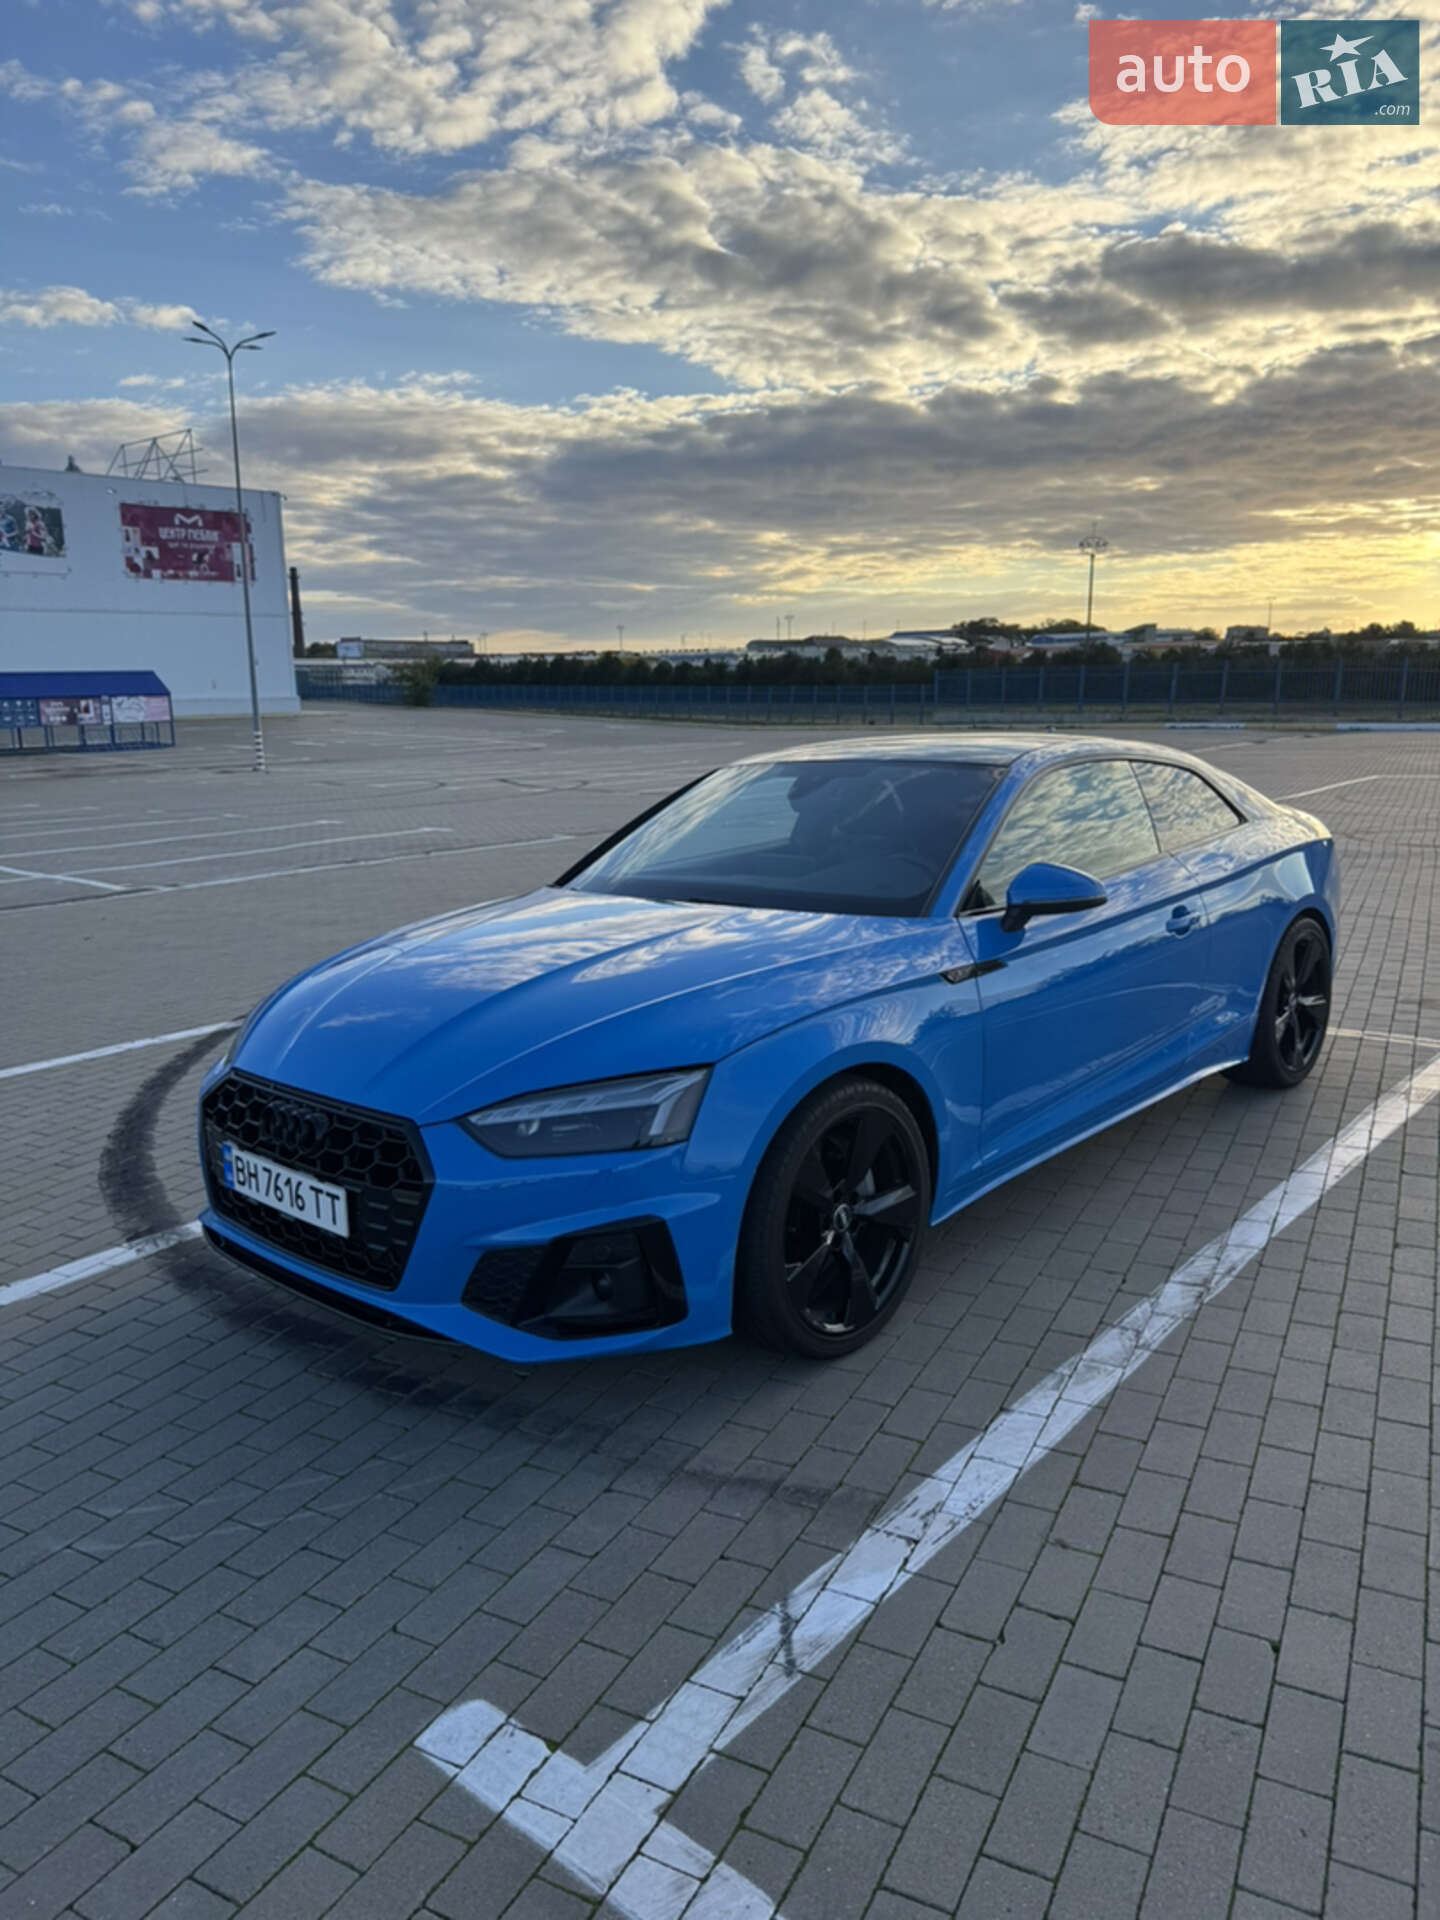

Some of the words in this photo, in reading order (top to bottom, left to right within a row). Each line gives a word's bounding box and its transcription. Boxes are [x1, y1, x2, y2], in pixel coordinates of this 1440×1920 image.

[234, 1155, 260, 1193] BH
[261, 1167, 306, 1212] 7616
[309, 1185, 341, 1226] TT
